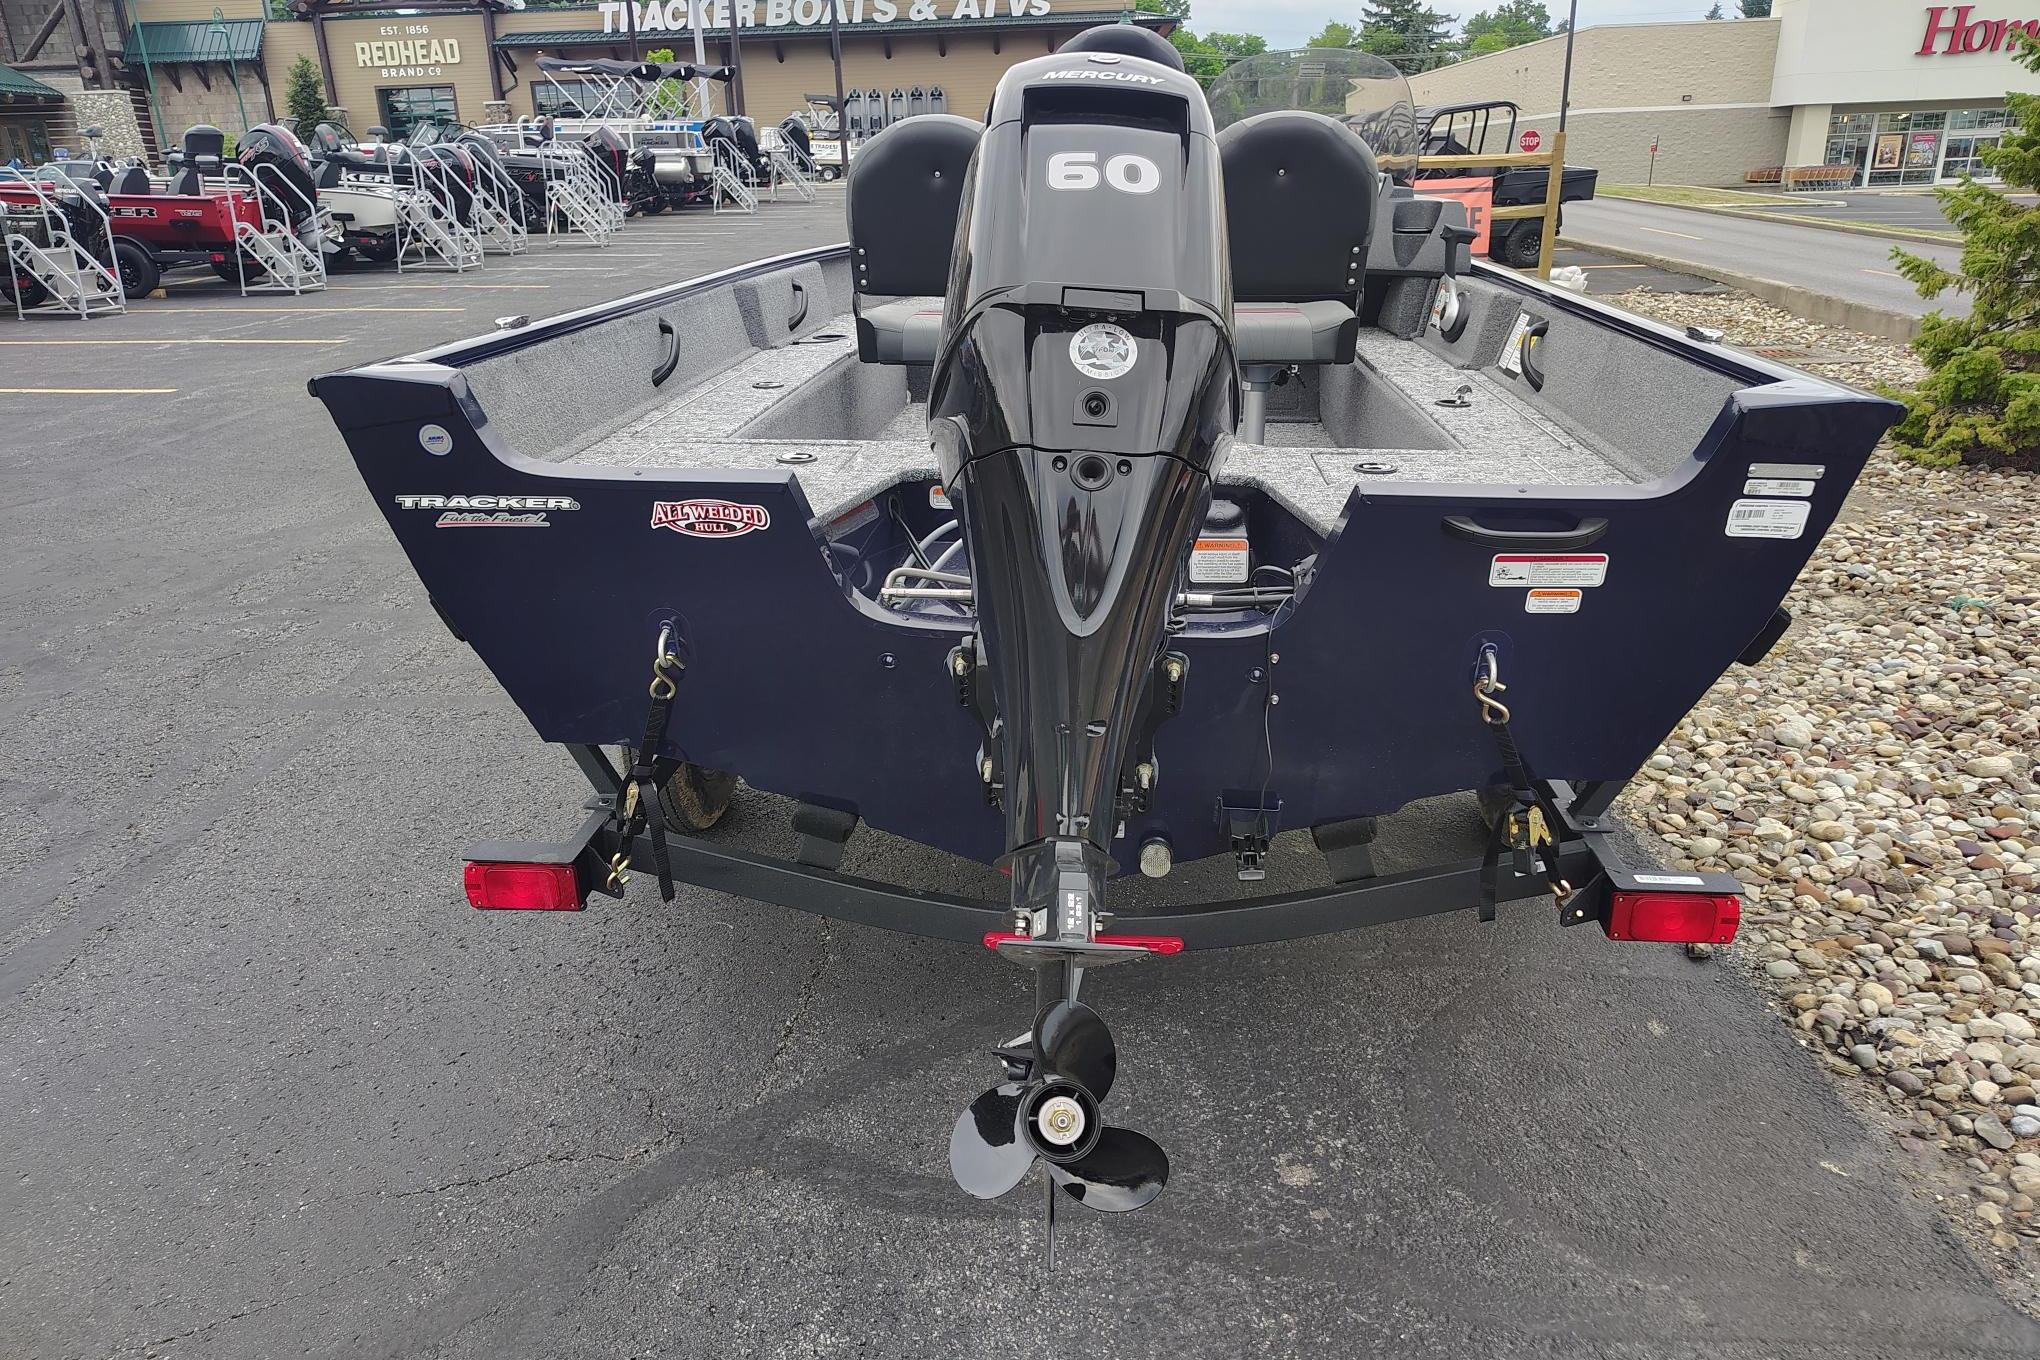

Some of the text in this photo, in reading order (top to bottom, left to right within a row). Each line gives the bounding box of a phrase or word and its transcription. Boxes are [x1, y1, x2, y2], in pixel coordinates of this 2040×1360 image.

[598, 0, 756, 33] TRACKER
[908, 0, 938, 21] &
[380, 24, 429, 36] EST. 1856
[354, 38, 461, 67] REDHEAD
[381, 67, 424, 78] BRAND
[1042, 70, 1166, 85] MERCURY
[1520, 136, 1540, 146] STOP
[1045, 151, 1162, 195] 60
[470, 512, 490, 523] the
[653, 503, 767, 527] ALL WELDED
[694, 522, 729, 533] HULL
